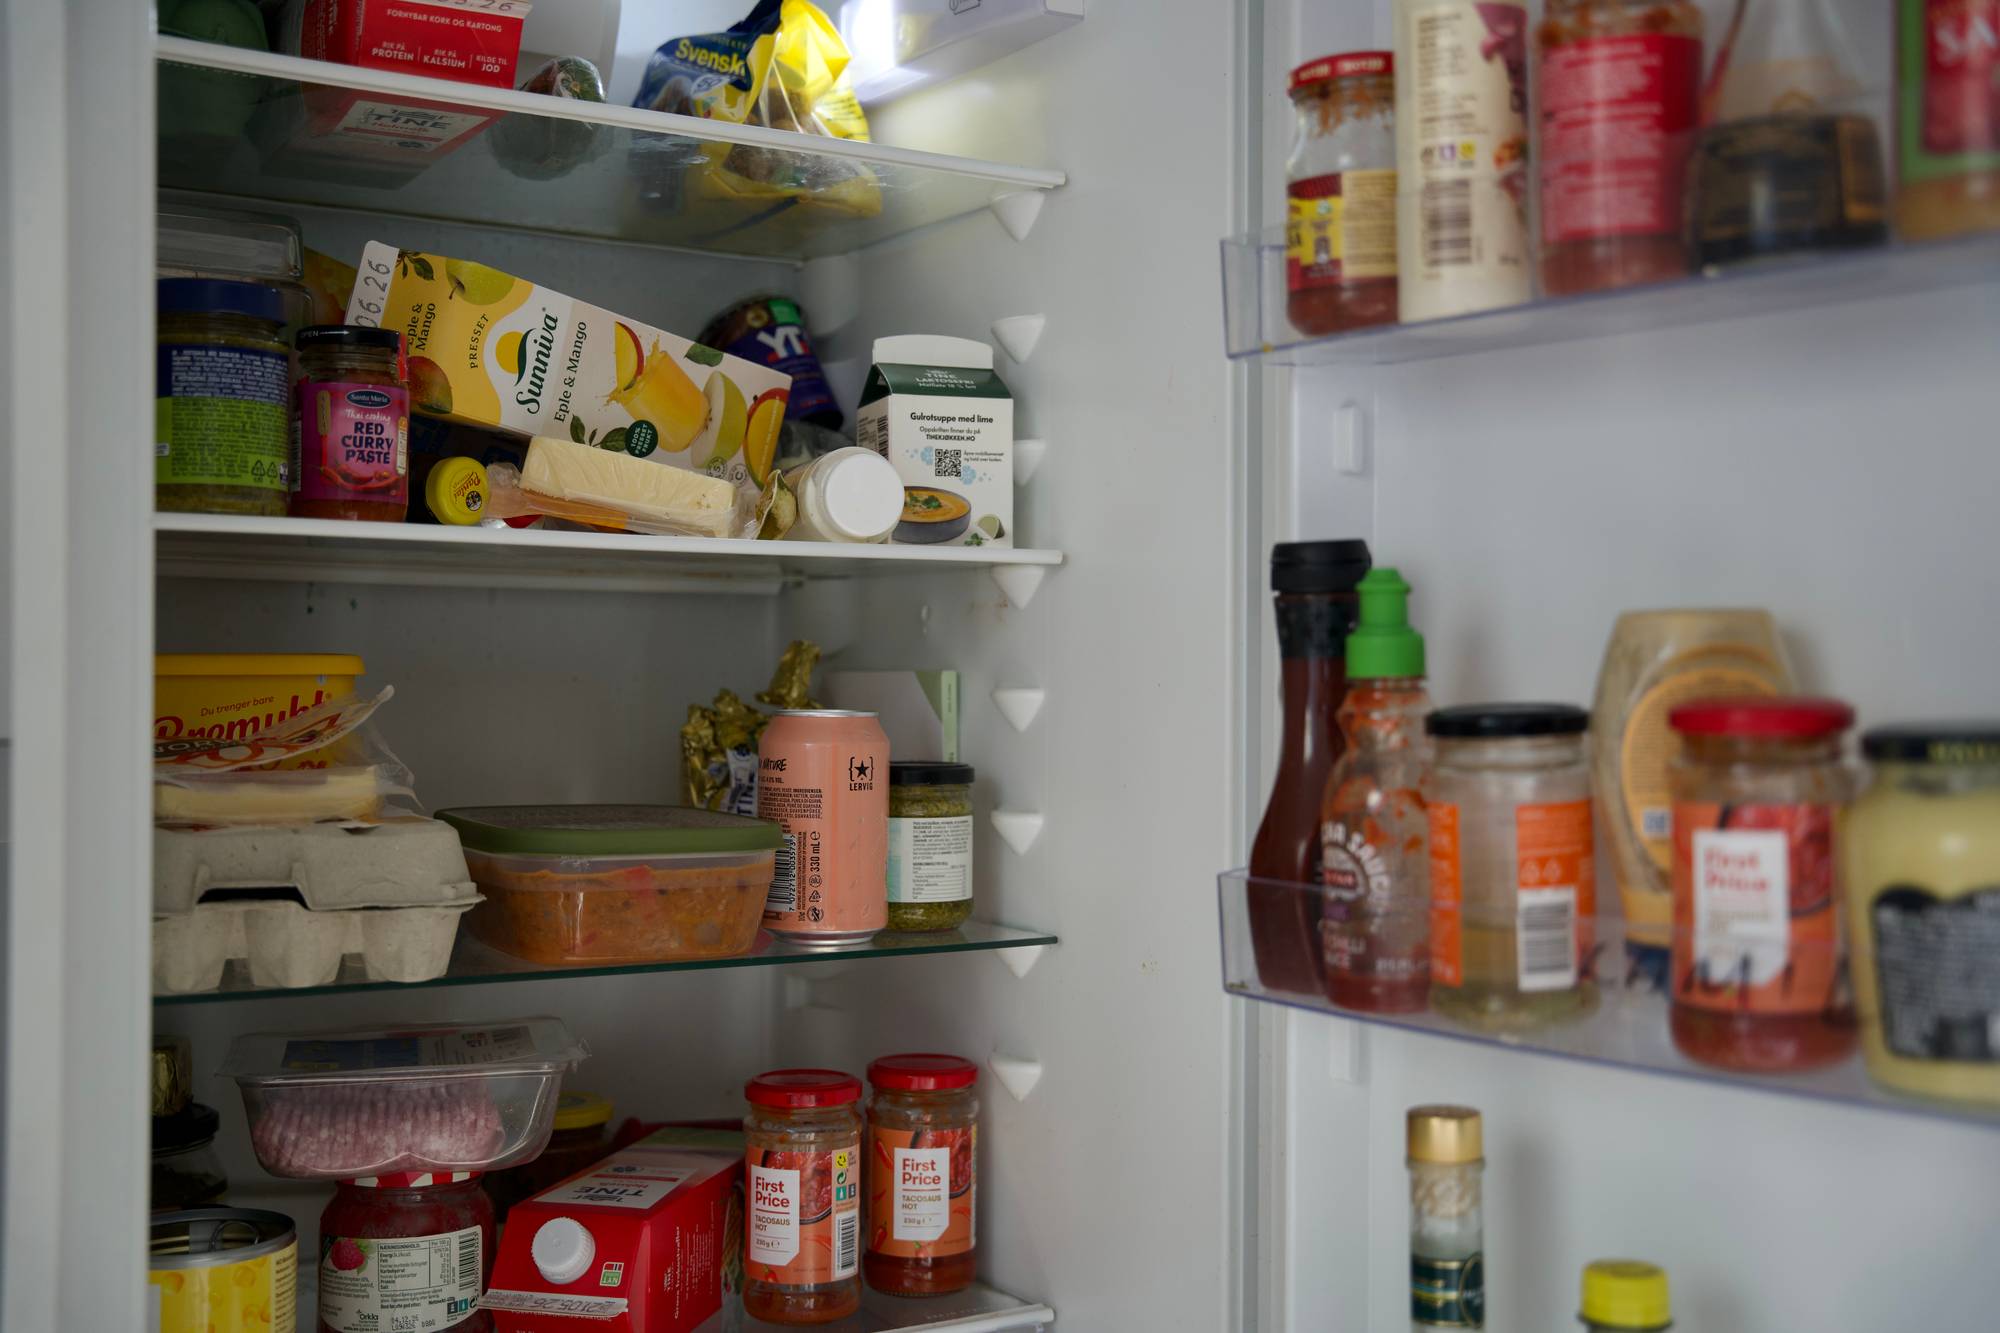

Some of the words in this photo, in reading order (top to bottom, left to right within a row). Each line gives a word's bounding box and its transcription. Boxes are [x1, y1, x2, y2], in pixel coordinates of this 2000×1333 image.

[387, 8, 428, 22] FORNYBAR
[429, 14, 450, 25] KORK
[452, 18, 465, 27] OG
[466, 21, 502, 33] KARTONG
[371, 47, 415, 61] PROTEIN
[423, 54, 466, 69] KALSIUM
[475, 55, 497, 64] KILDE
[481, 63, 501, 73] JOD
[411, 303, 423, 313] &
[415, 302, 436, 351] Mango
[469, 313, 489, 369] PRESSET
[566, 321, 588, 373] Mango
[515, 313, 558, 415] Sunniva
[563, 376, 576, 388] &
[554, 390, 572, 422] Eple
[910, 412, 957, 424] Gulrotsuppe
[958, 414, 976, 423] med
[977, 414, 994, 423] lime
[354, 421, 384, 436] RED
[341, 435, 394, 451] CURRY
[630, 426, 641, 448] 100%
[345, 449, 391, 465] PASTE
[200, 707, 215, 717] Du
[215, 700, 251, 715] trenger
[252, 695, 275, 707] bare
[849, 782, 873, 791] LERVIG
[810, 856, 820, 872] 330
[902, 1158, 936, 1172] First
[755, 1176, 785, 1193] First
[902, 1172, 942, 1185] Price
[574, 1185, 645, 1198] TINE
[755, 1191, 790, 1208] Price
[755, 1215, 791, 1226] TACOSAUS
[755, 1224, 768, 1232] HOT
[359, 1313, 379, 1321] Orkla
